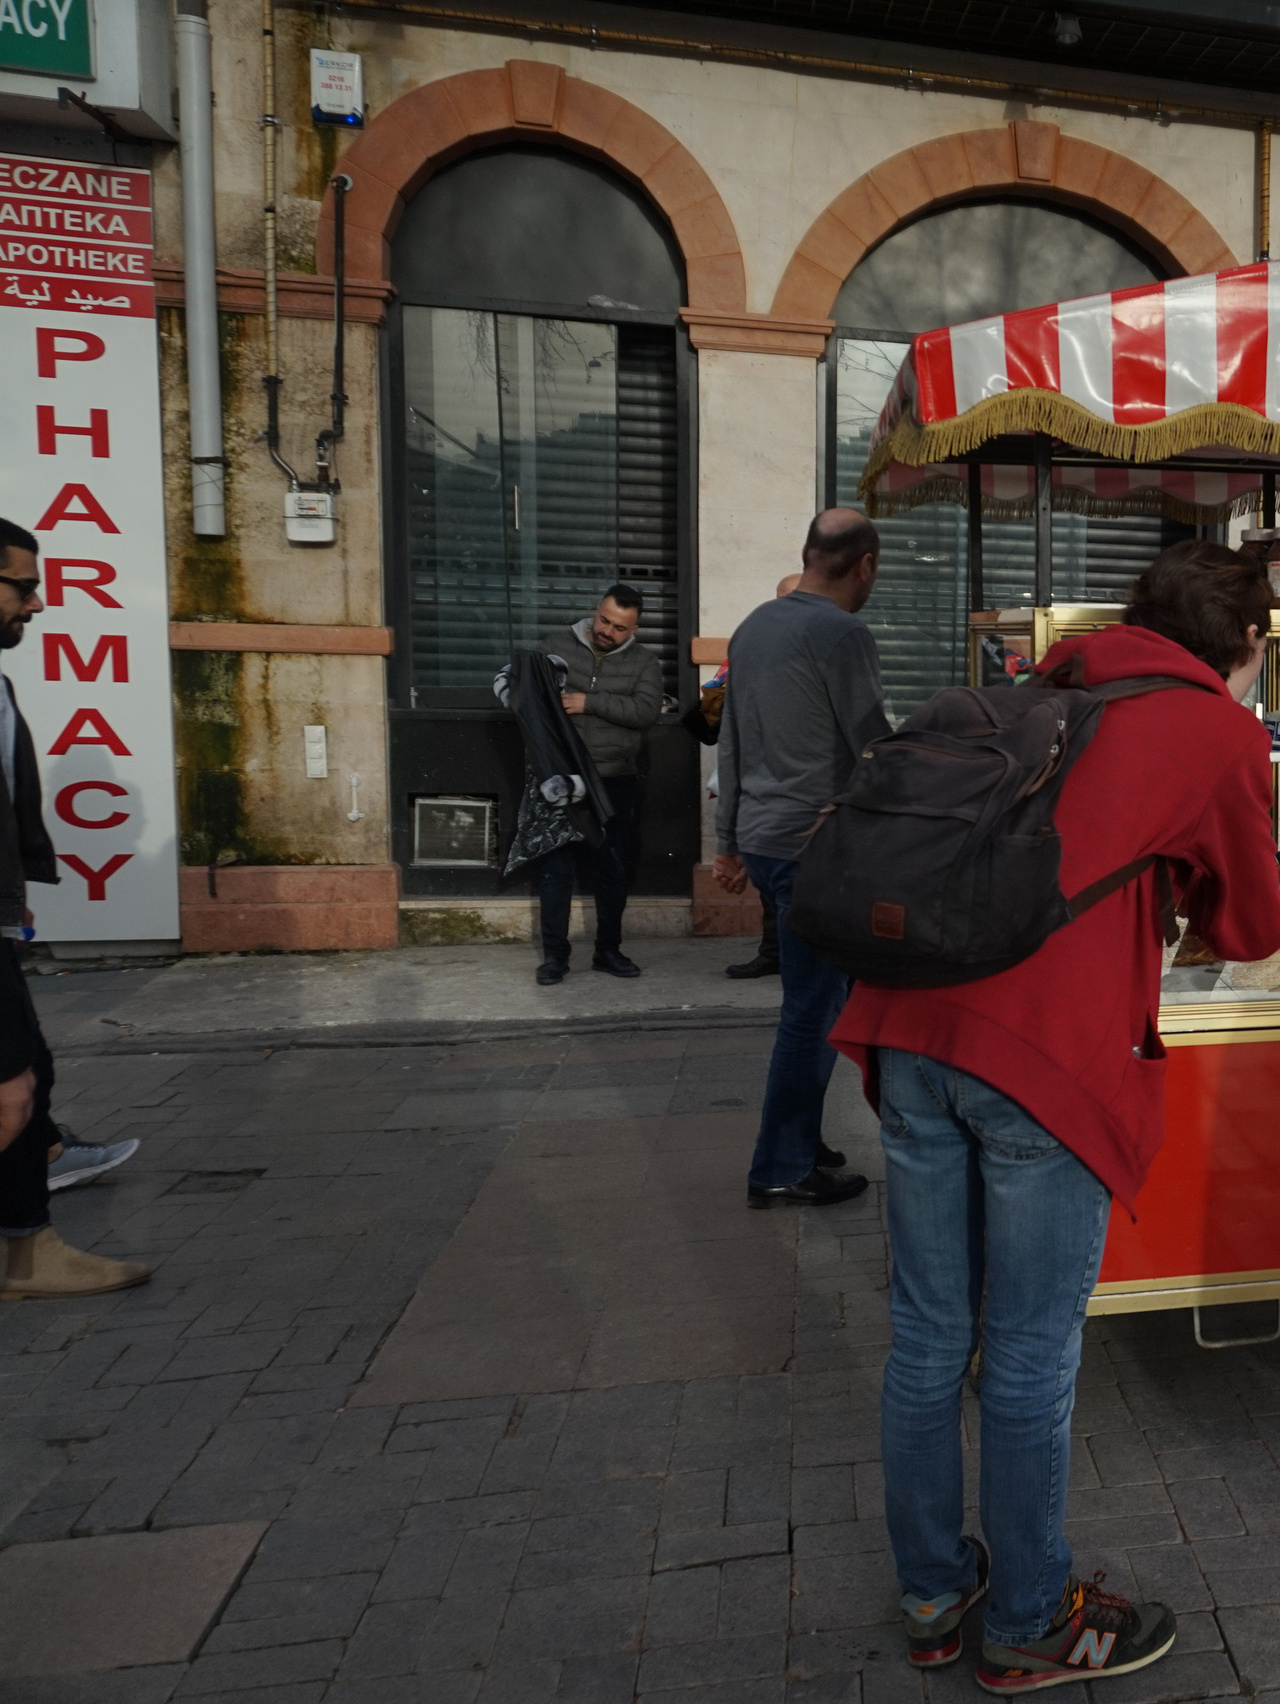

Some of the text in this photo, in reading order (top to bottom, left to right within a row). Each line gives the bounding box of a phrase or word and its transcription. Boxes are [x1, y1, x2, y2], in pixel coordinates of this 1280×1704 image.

[0, 203, 130, 237] АПТЕКА
[34, 327, 134, 901] PHARMACY
[1067, 1628, 1117, 1669] N
